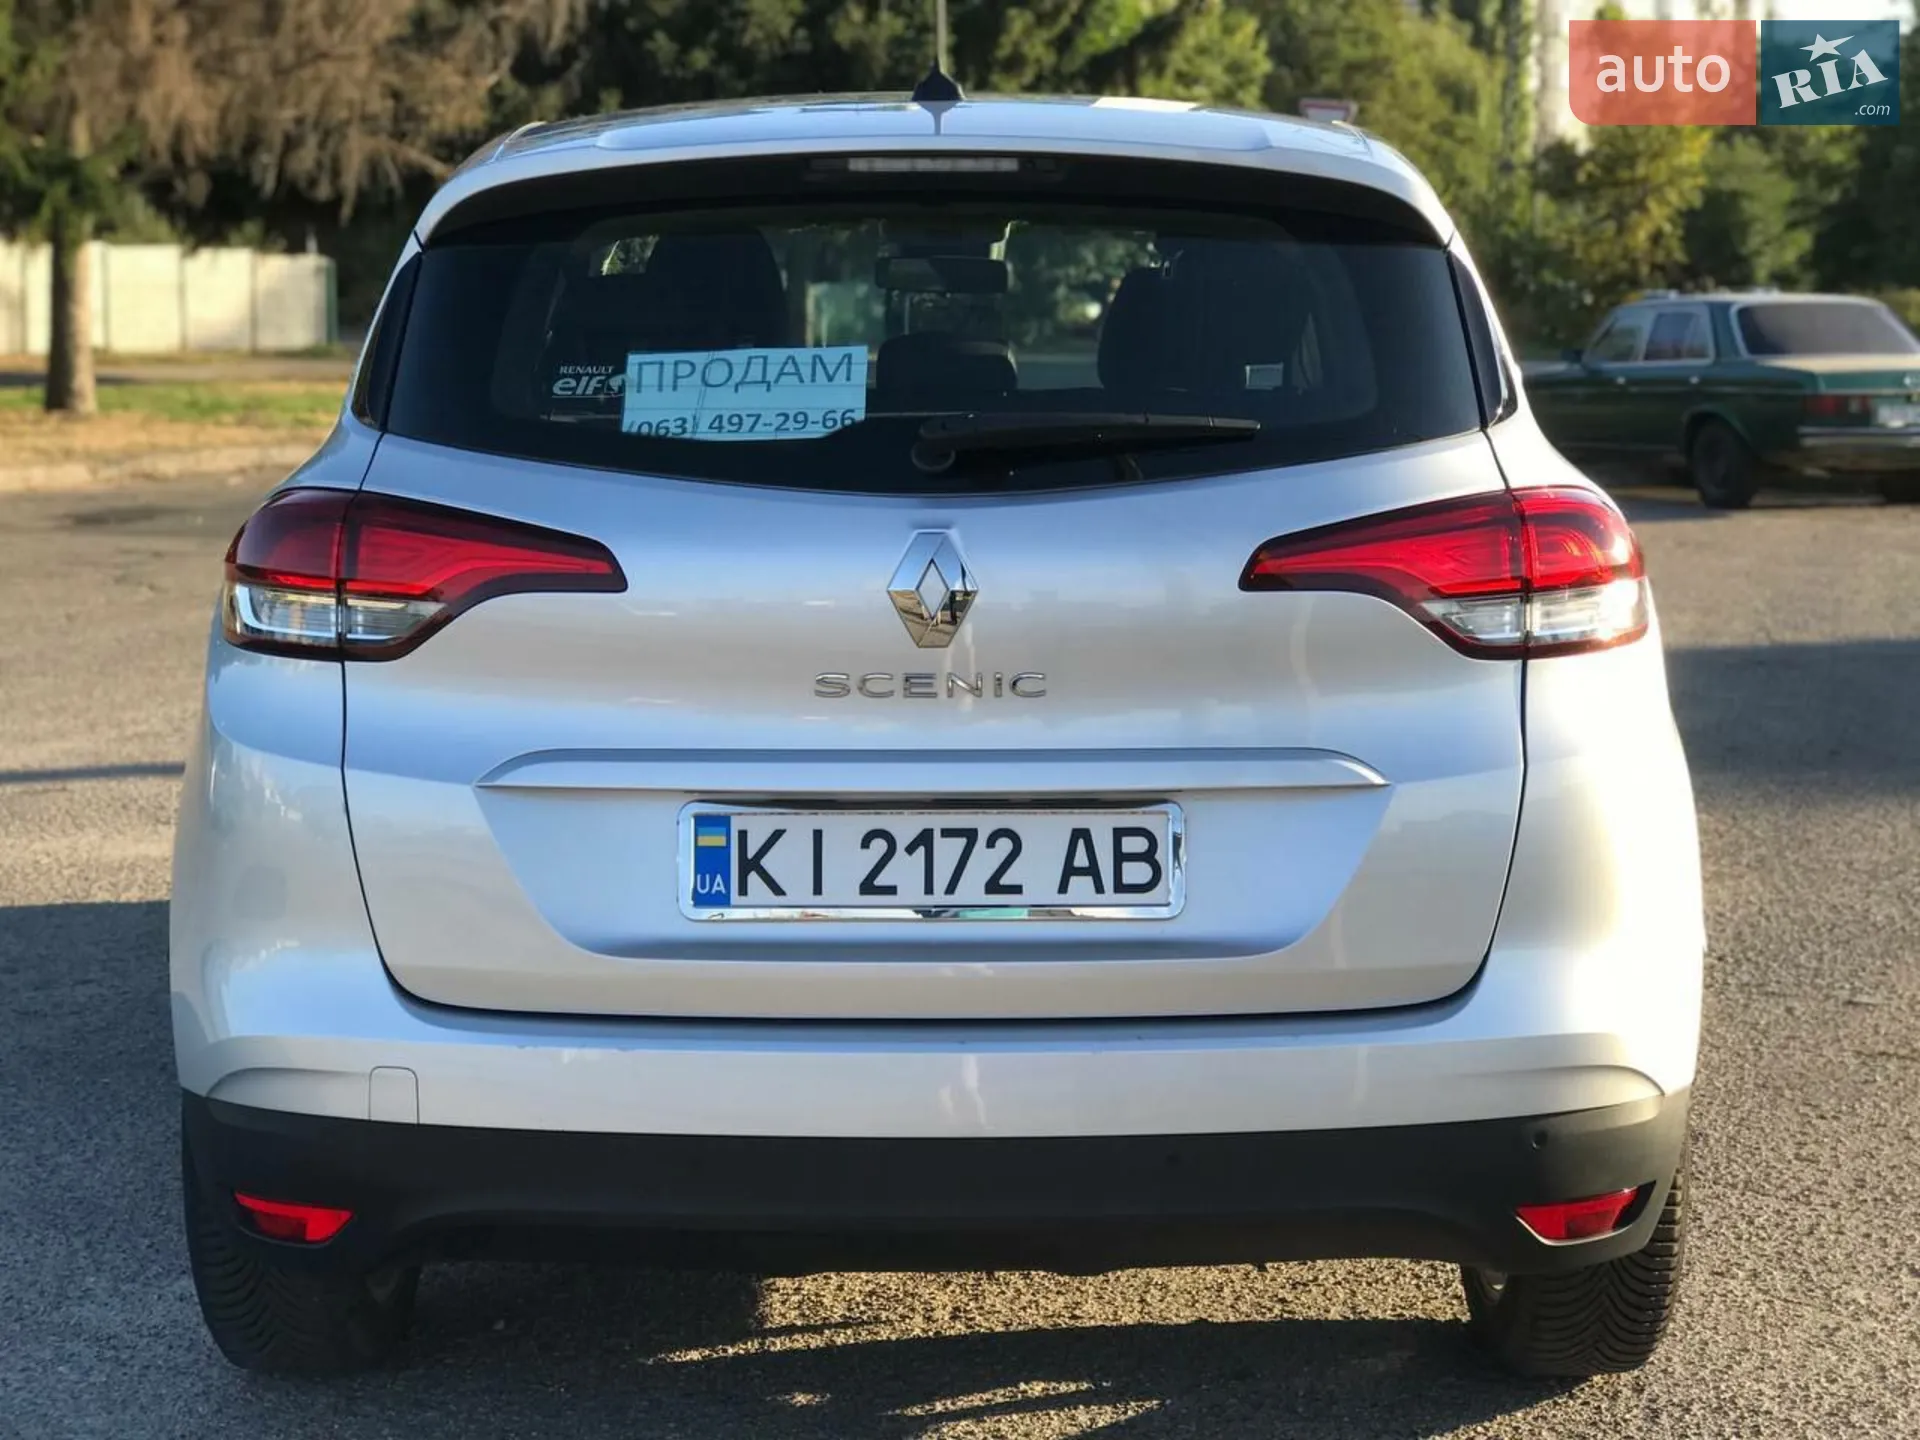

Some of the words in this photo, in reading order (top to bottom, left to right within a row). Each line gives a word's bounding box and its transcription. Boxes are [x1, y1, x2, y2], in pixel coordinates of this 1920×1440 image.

[559, 365, 614, 374] RENAULT
[635, 352, 853, 394] ПРОДАМ
[552, 376, 606, 395] elf
[708, 409, 856, 433] 497-29-66
[814, 672, 1047, 698] SCENIC
[859, 828, 1023, 895] 2172
[1057, 827, 1163, 895] AB
[696, 873, 726, 895] UA
